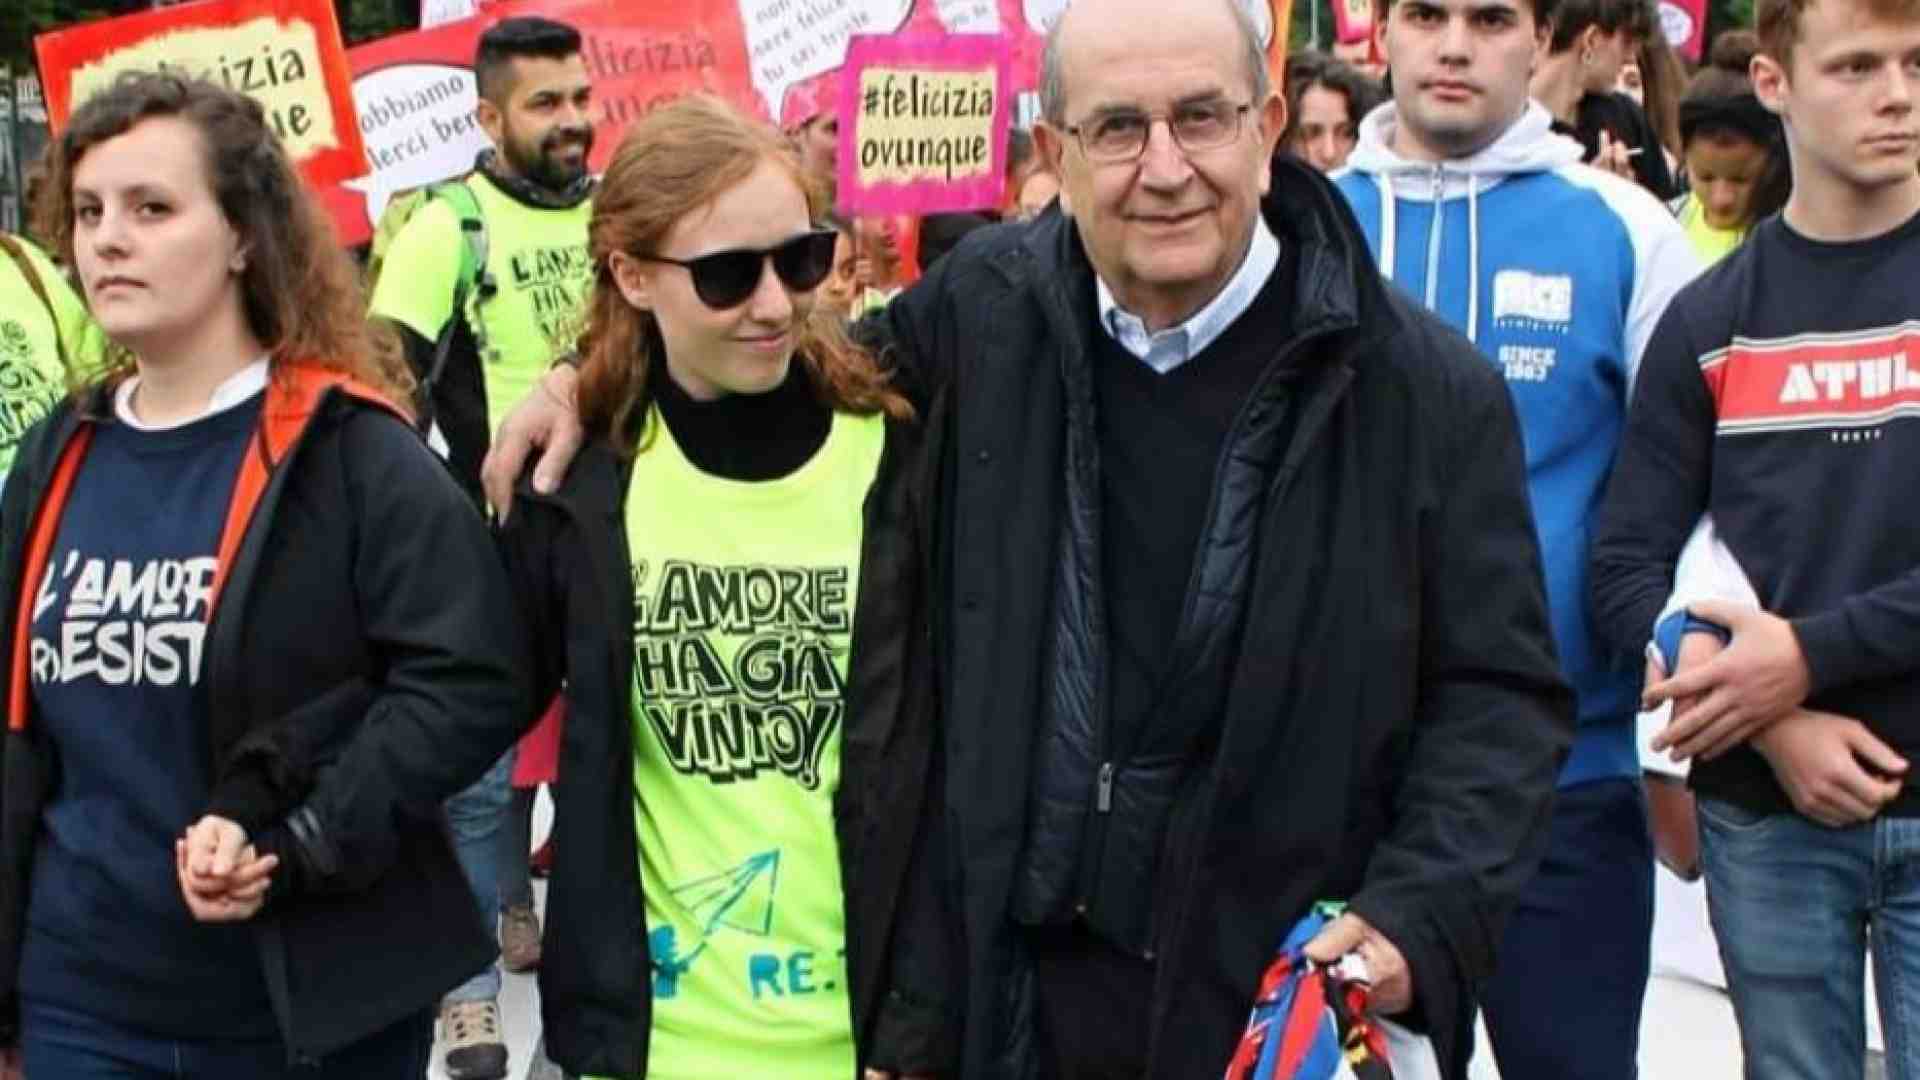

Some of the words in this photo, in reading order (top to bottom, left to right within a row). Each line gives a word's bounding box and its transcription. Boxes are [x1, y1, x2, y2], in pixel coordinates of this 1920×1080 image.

[588, 31, 717, 76] licizia
[361, 76, 464, 134] obbiamo
[864, 74, 993, 118] #felicizia
[366, 128, 430, 172] lerci
[861, 134, 986, 184] ovunque
[32, 549, 219, 624] L'AMOR
[634, 632, 738, 700] HA
[749, 948, 846, 1000] RE.
